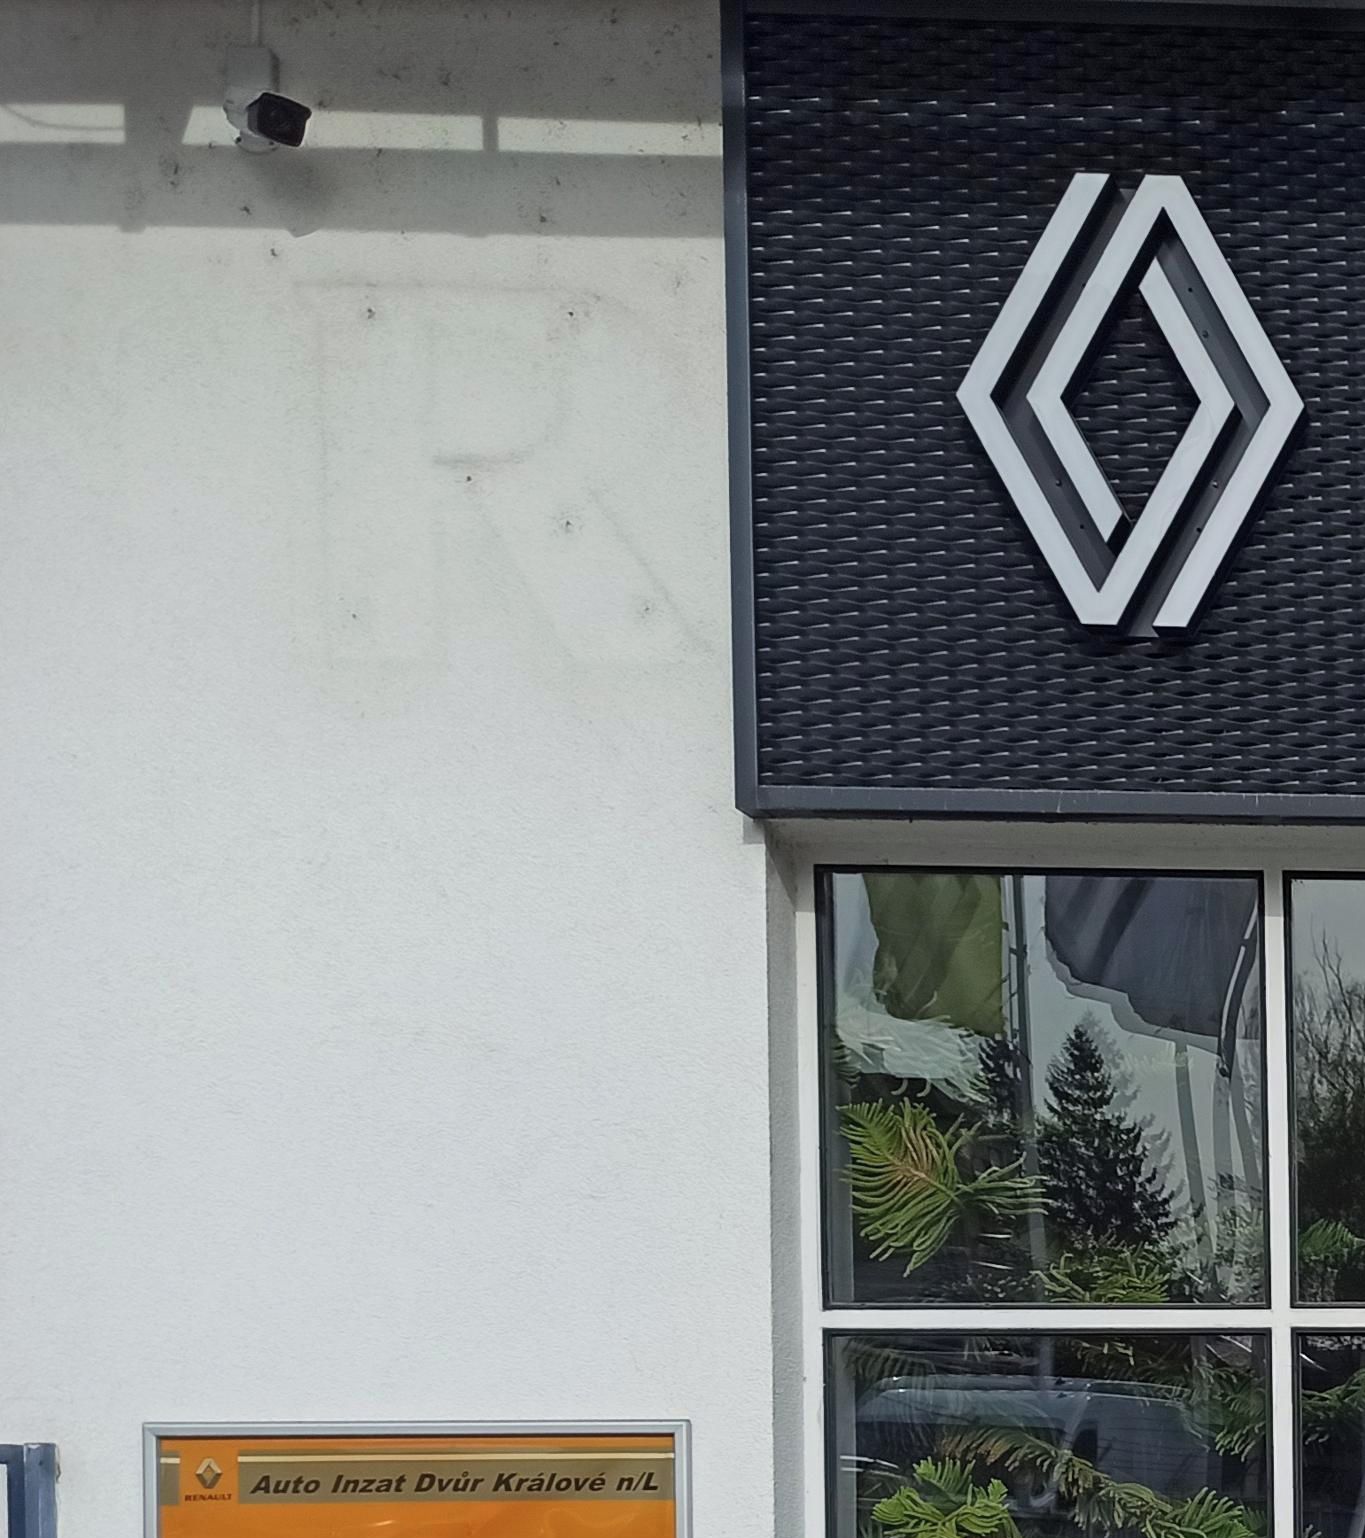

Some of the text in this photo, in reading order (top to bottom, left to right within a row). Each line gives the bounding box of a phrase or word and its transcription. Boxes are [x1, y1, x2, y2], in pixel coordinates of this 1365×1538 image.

[249, 1471, 660, 1495] Auto Inzat Dvůr Králové n/L
